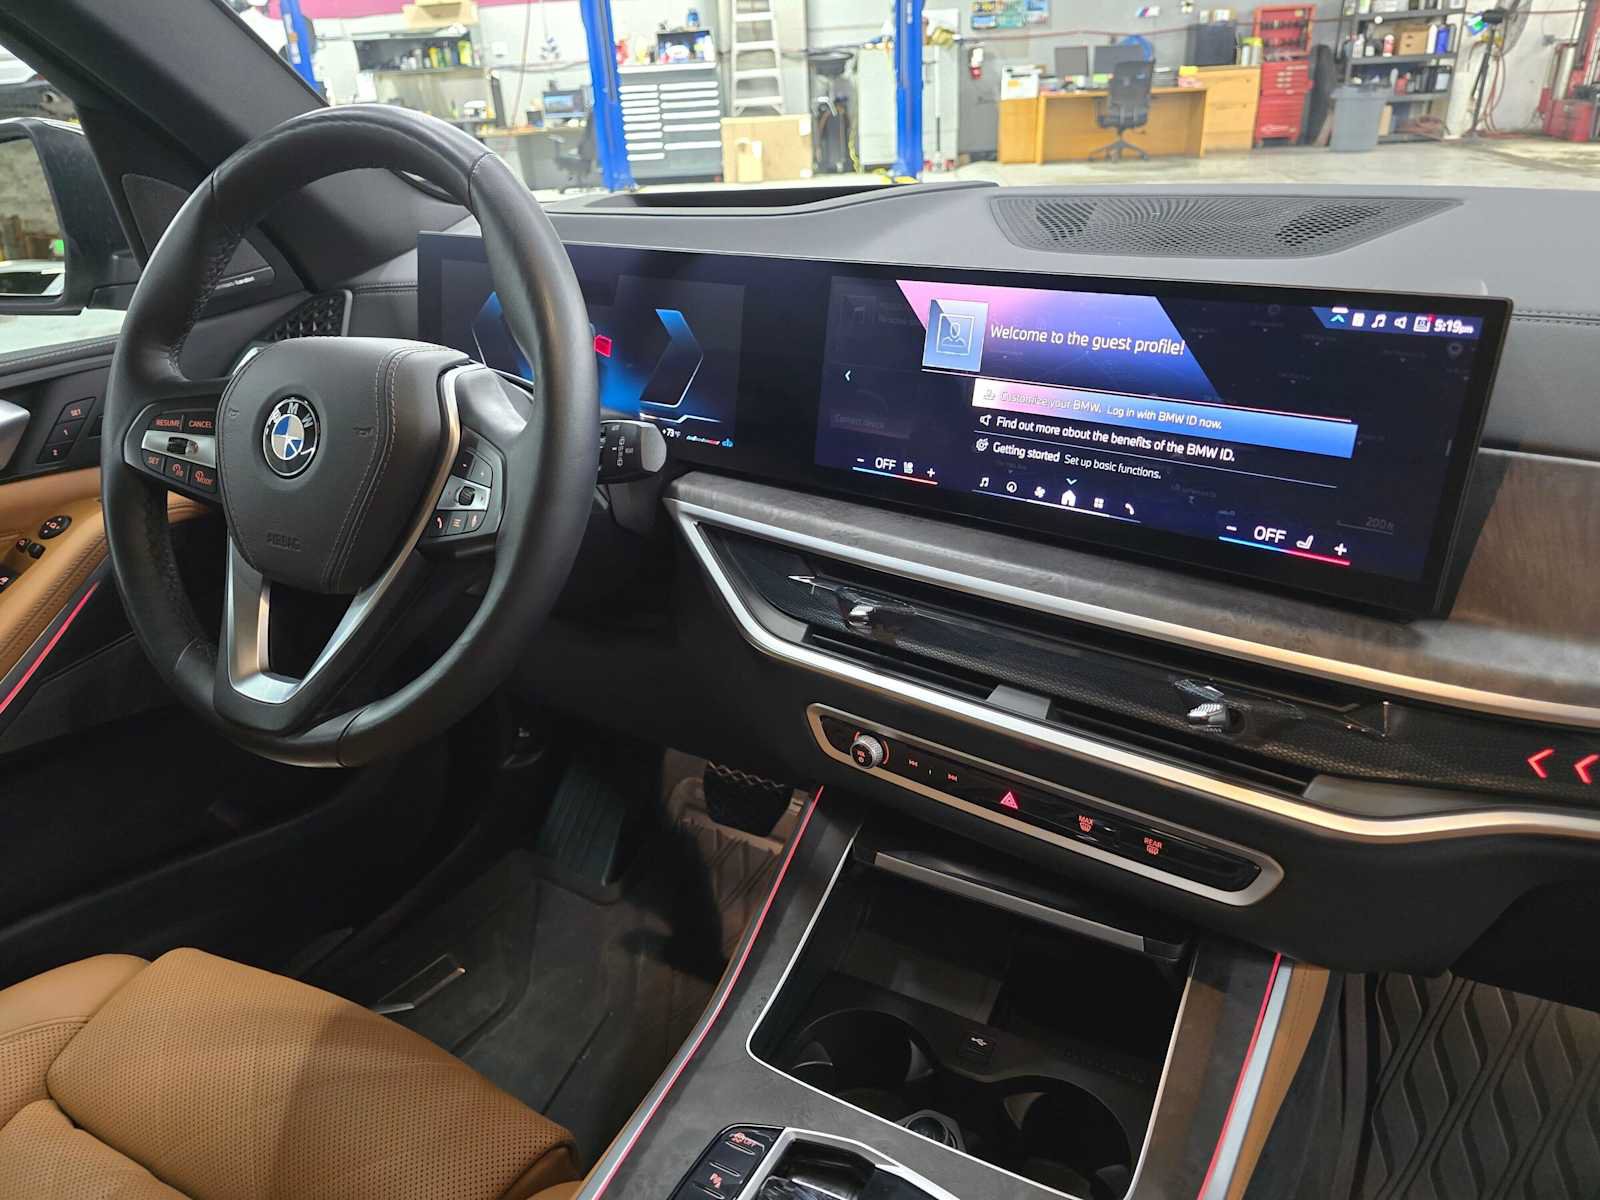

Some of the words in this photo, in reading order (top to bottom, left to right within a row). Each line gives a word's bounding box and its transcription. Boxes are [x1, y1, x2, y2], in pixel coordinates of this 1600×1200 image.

[990, 324, 1047, 343] Welcome
[1051, 328, 1064, 344] to
[1067, 331, 1089, 346] the
[1092, 335, 1131, 351] guest
[1134, 338, 1185, 355] profile!
[1001, 391, 1049, 407] Customize
[1050, 399, 1071, 410] your
[1073, 399, 1101, 413] BMW.
[1107, 406, 1124, 418] Log
[1126, 407, 1135, 417] in
[1136, 409, 1156, 420] with
[1158, 411, 1184, 425] BMW
[1186, 415, 1198, 426] ID
[1199, 418, 1222, 430] now.
[188, 420, 213, 429] CANCEL
[996, 415, 1018, 429] Find
[1018, 422, 1035, 432] out
[1035, 424, 1061, 435] more
[1062, 426, 1091, 440] about
[1092, 430, 1109, 442] the
[1111, 432, 1152, 449] benefits
[1153, 439, 1166, 451] of
[1166, 442, 1185, 454] the
[1187, 443, 1218, 460] BMW
[1219, 448, 1235, 462] ID.
[875, 457, 897, 471] OFF
[993, 442, 1026, 459] Getting
[1027, 448, 1061, 463] started
[1064, 454, 1080, 466] Set
[1080, 458, 1093, 469] up
[1093, 459, 1117, 472] basic
[1117, 462, 1162, 479] functions.
[1254, 525, 1287, 544] OFF
[1078, 815, 1094, 826] MAX
[1143, 837, 1163, 849] REAR
